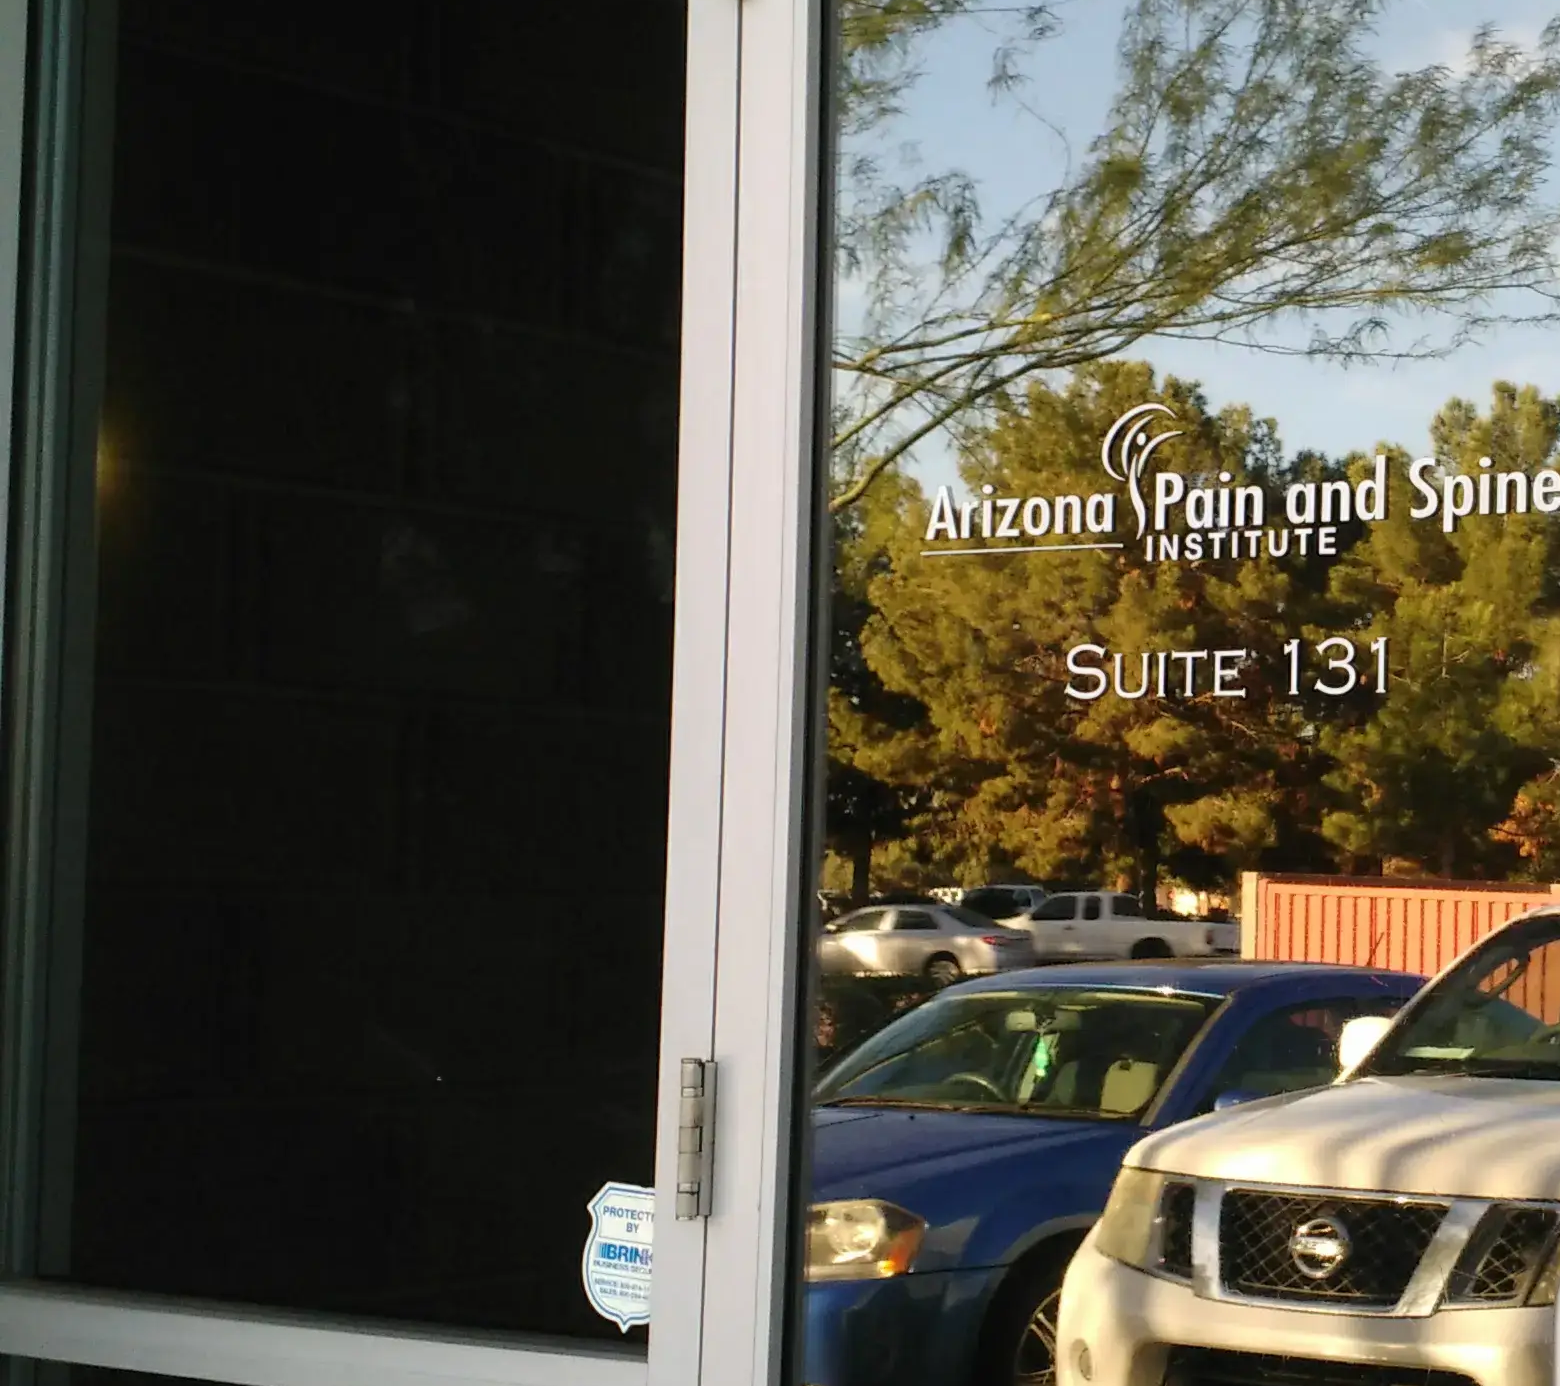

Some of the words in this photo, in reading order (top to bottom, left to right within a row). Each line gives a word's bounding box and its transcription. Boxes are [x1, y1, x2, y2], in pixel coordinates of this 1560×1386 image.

[925, 485, 1115, 541] Arizona
[1154, 470, 1264, 531] Pain
[1285, 454, 1387, 523] and
[1145, 526, 1338, 562] INSTITUTE
[1063, 643, 1248, 701] SUITE
[1282, 636, 1389, 696] 131
[626, 1222, 640, 1234] BY
